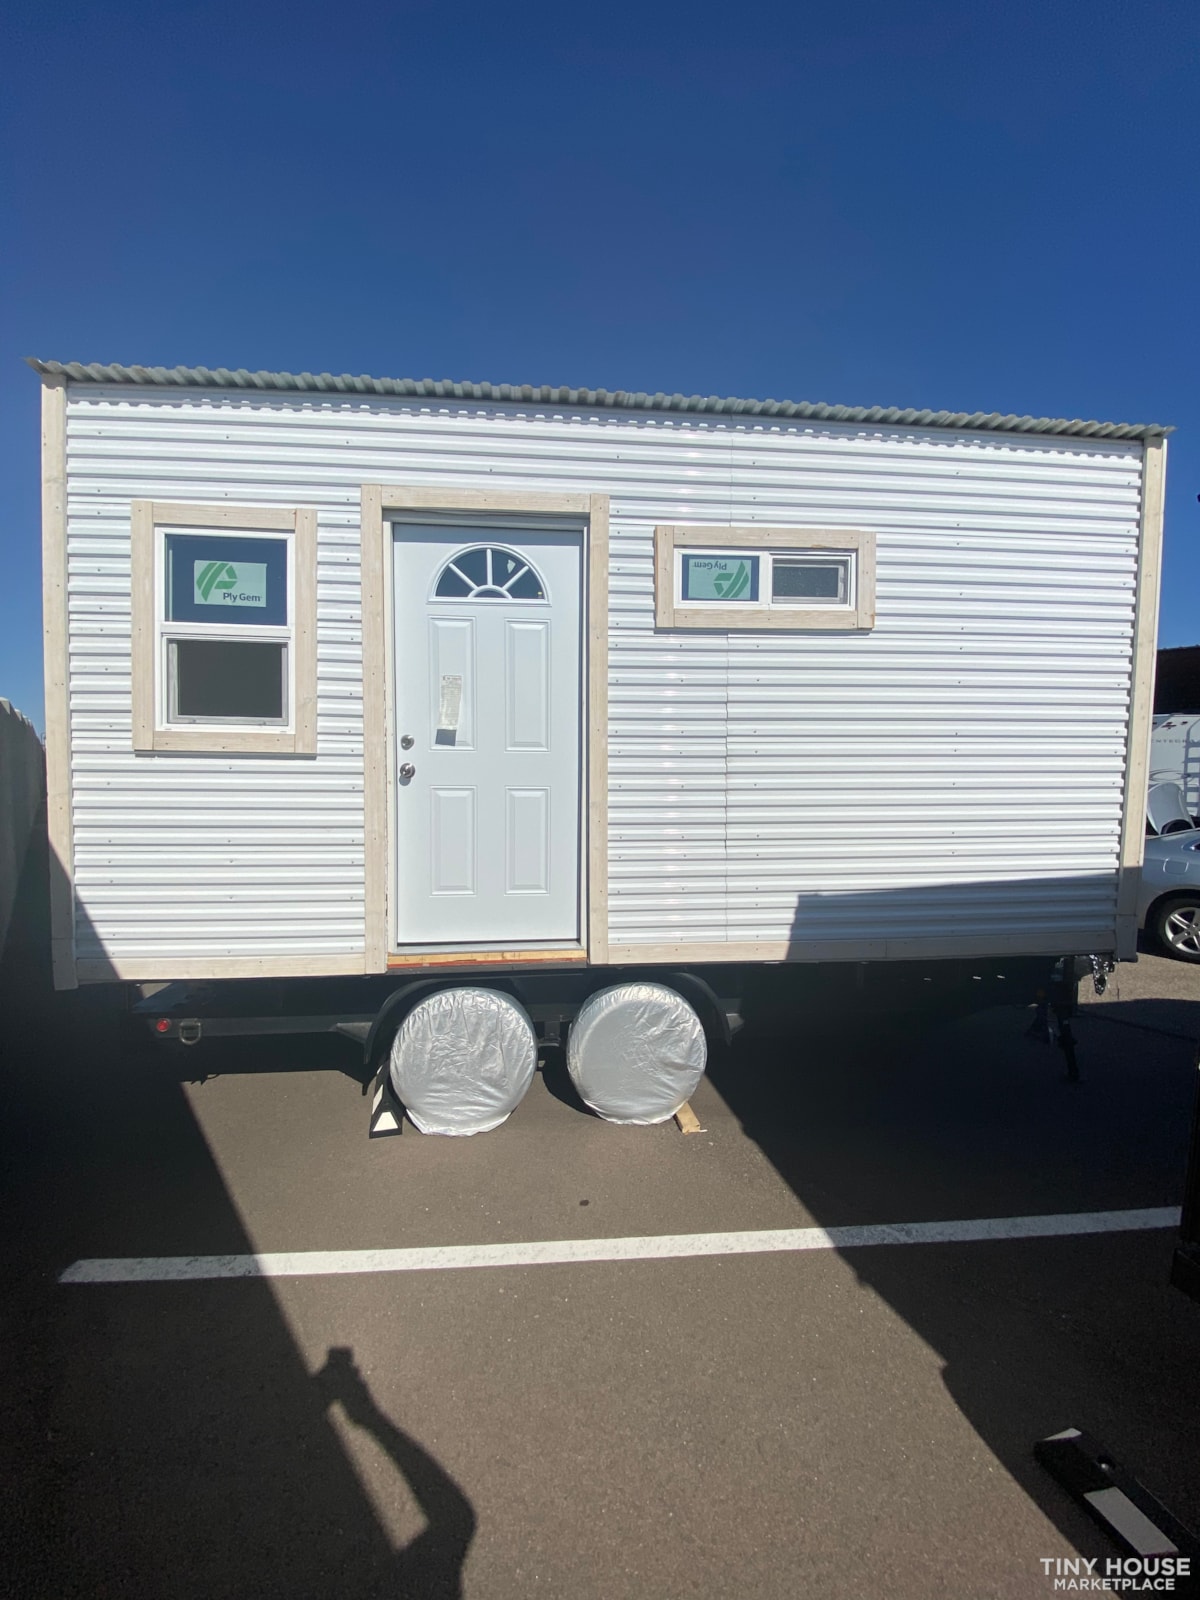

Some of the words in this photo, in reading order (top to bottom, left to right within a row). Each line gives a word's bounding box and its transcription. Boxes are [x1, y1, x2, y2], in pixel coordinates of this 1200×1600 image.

[694, 561, 713, 570] Gem
[714, 561, 727, 570] Ply
[223, 592, 237, 603] Ply
[239, 593, 261, 602] Gem
